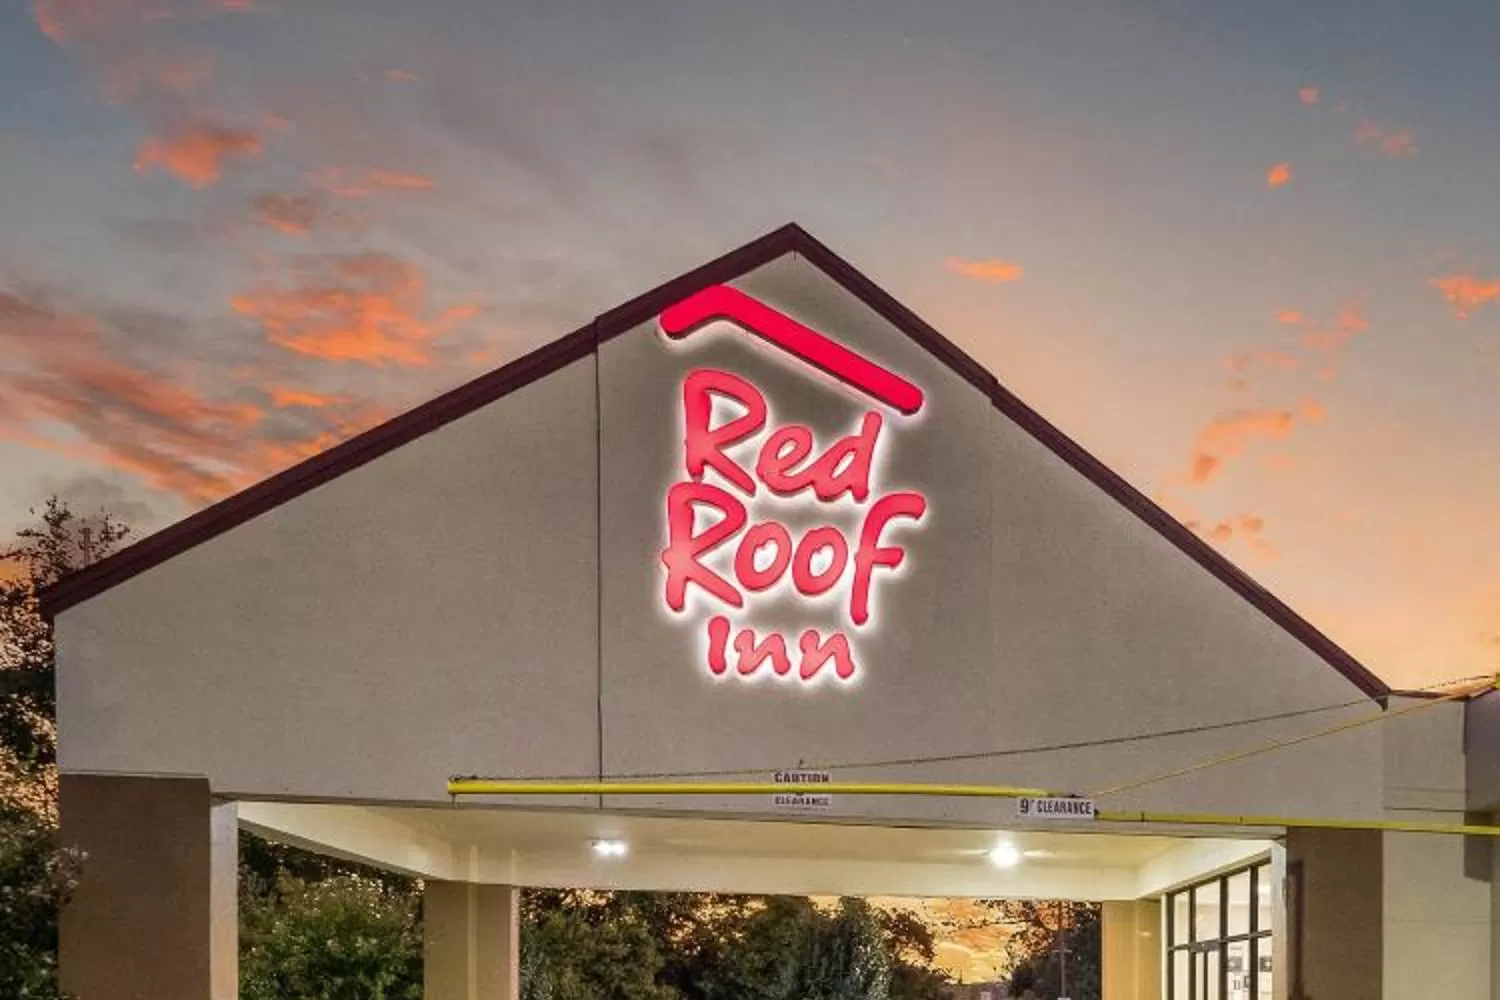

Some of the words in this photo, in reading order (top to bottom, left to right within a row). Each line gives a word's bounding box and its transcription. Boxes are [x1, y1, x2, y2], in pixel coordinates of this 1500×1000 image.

[684, 369, 883, 502] Red
[662, 482, 927, 625] Roof
[708, 615, 856, 680] Inn
[774, 771, 829, 783] CAUTION
[1037, 799, 1092, 814] CLEARANCE
